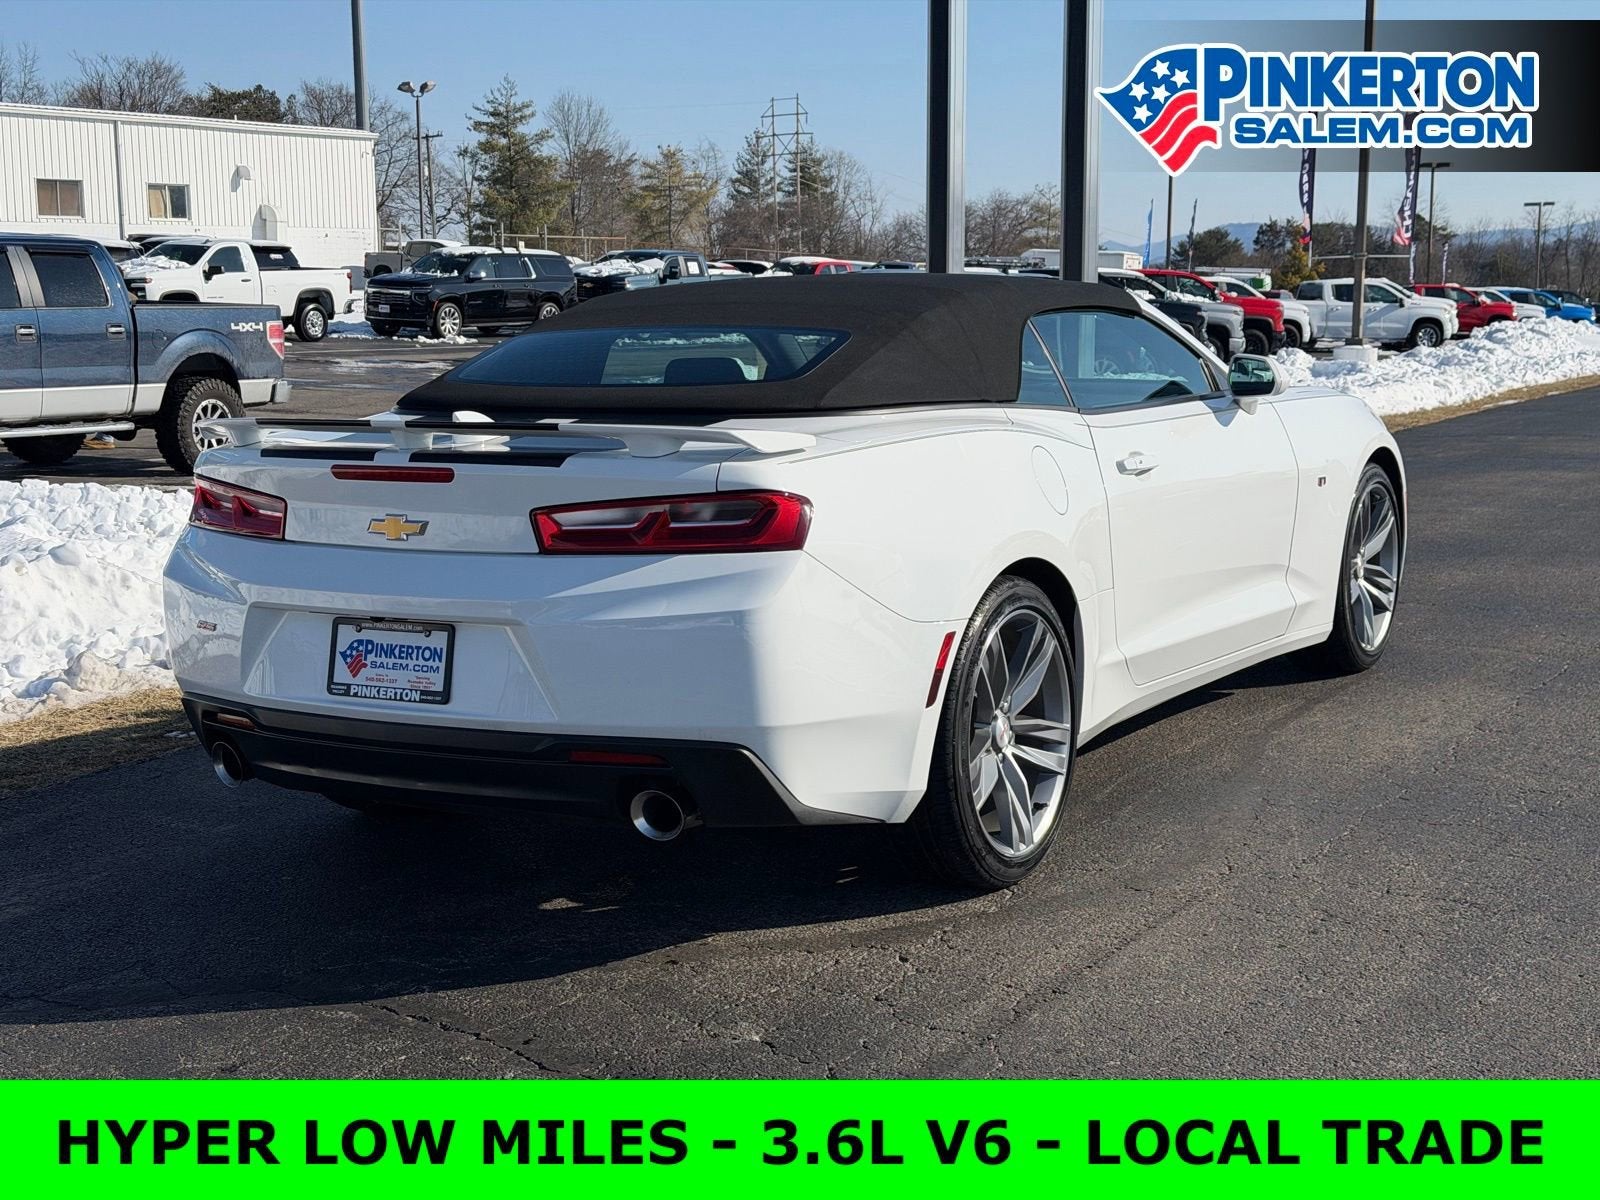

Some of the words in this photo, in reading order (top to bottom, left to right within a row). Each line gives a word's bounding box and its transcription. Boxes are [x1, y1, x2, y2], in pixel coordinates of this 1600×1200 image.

[363, 639, 444, 663] PINKERTON
[369, 661, 440, 674] SALEM.COM
[350, 685, 421, 702] PINKERTON
